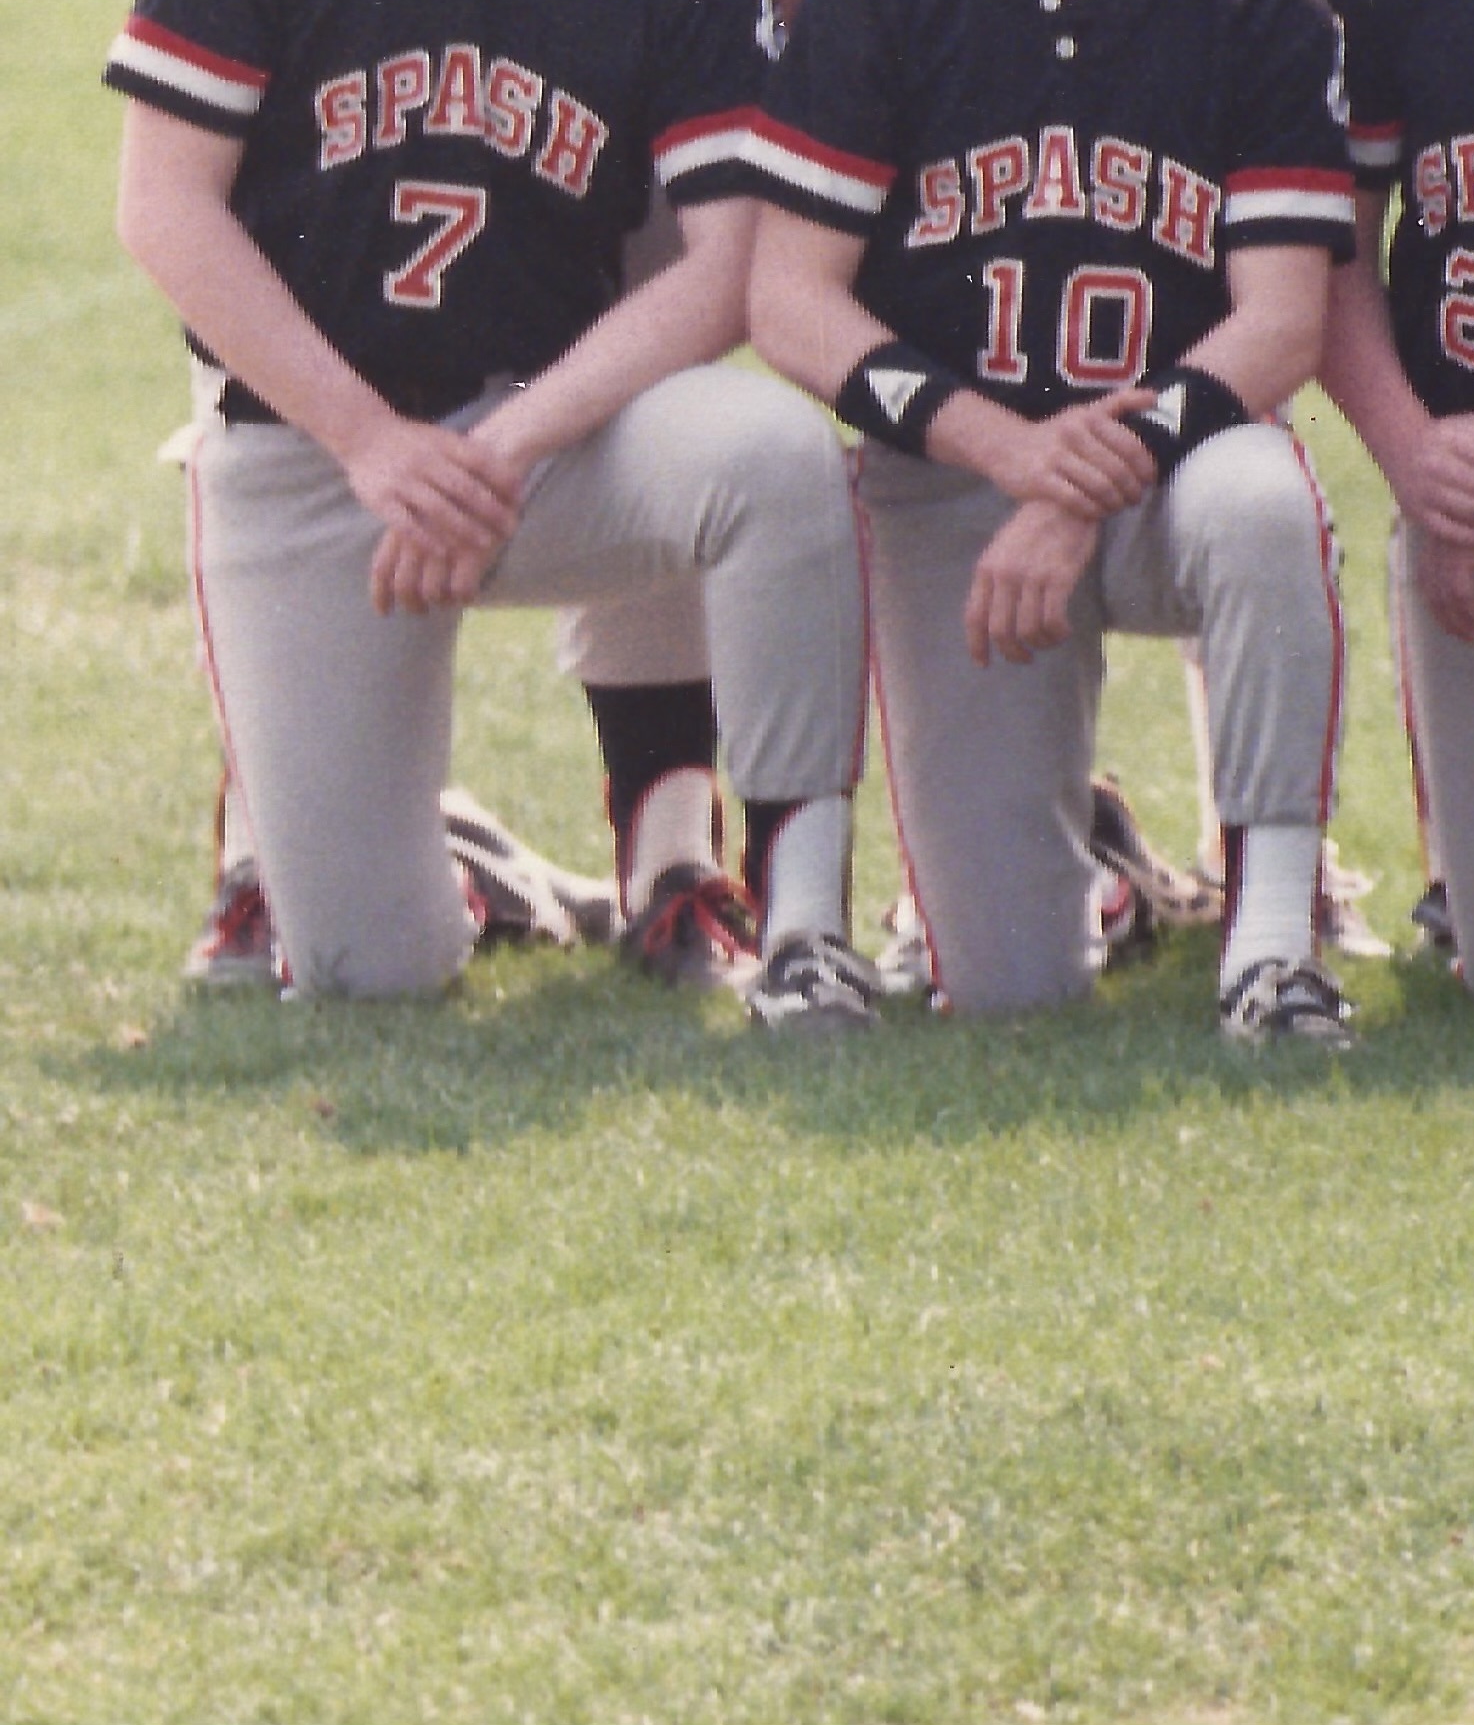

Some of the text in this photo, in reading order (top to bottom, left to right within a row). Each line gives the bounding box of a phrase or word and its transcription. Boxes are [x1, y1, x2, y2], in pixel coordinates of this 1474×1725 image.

[315, 44, 609, 197] SPASH
[382, 181, 486, 308] 7
[906, 125, 1220, 269] SPASH
[978, 258, 1154, 388] 10
